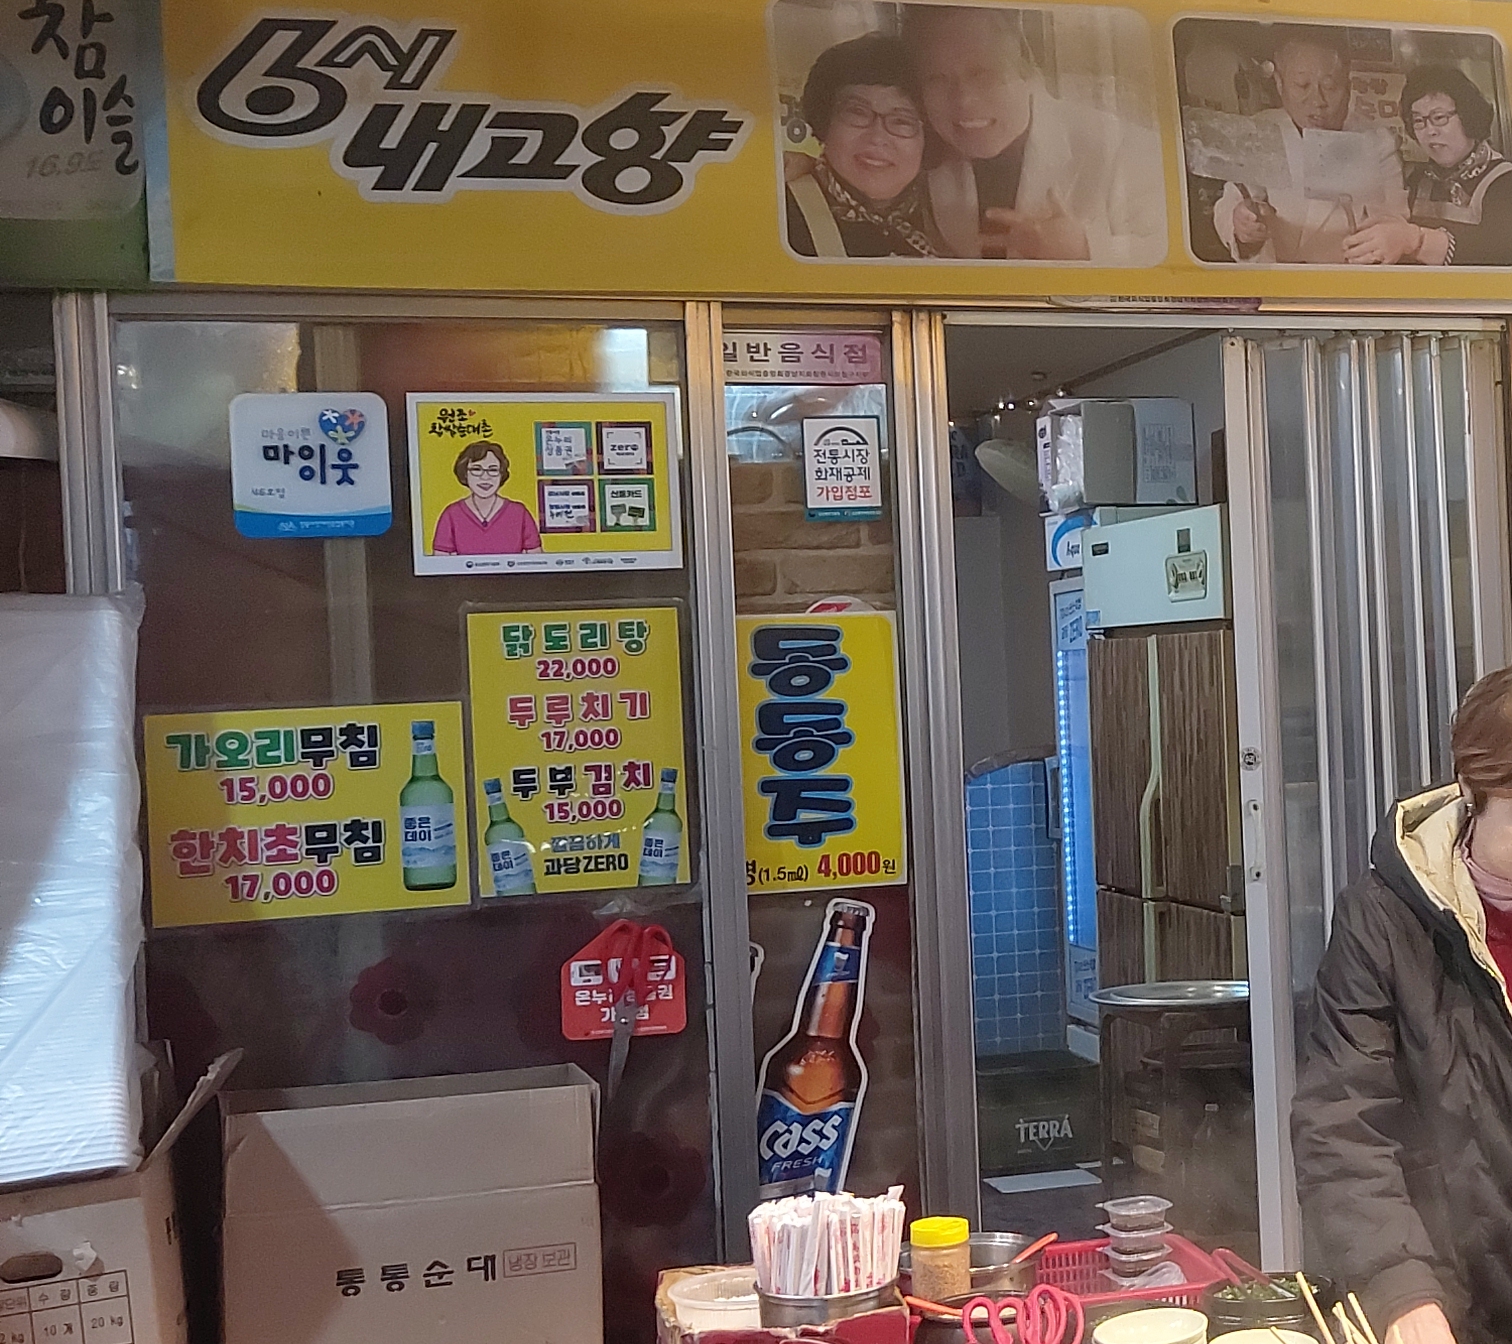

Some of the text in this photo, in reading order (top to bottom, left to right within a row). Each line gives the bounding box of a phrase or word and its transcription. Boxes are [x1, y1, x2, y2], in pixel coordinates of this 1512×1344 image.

[197, 18, 456, 137] 6시
[343, 92, 744, 205] 내고향
[813, 448, 870, 465] 전통시장
[815, 467, 870, 483] 화재공제
[817, 485, 873, 501] 가입점포
[501, 620, 650, 659] 닭도리탕
[536, 656, 619, 681] 22,000
[507, 691, 651, 729] 두루치기
[166, 723, 379, 772] 가오리무침
[540, 728, 622, 752] 17,000
[748, 625, 856, 849] 동동주
[220, 773, 334, 805] 15,000
[510, 761, 653, 800] 두부김치
[543, 799, 625, 824] 15,000
[169, 819, 385, 876] 한치초무침
[544, 853, 629, 876] 과당ZERO
[225, 869, 338, 902] 17,000
[1015, 1116, 1073, 1144] TERRA
[770, 1155, 823, 1172] FRESH
[336, 1249, 571, 1297] 통통순대 냉장 보관
[91, 1315, 105, 1329] 20
